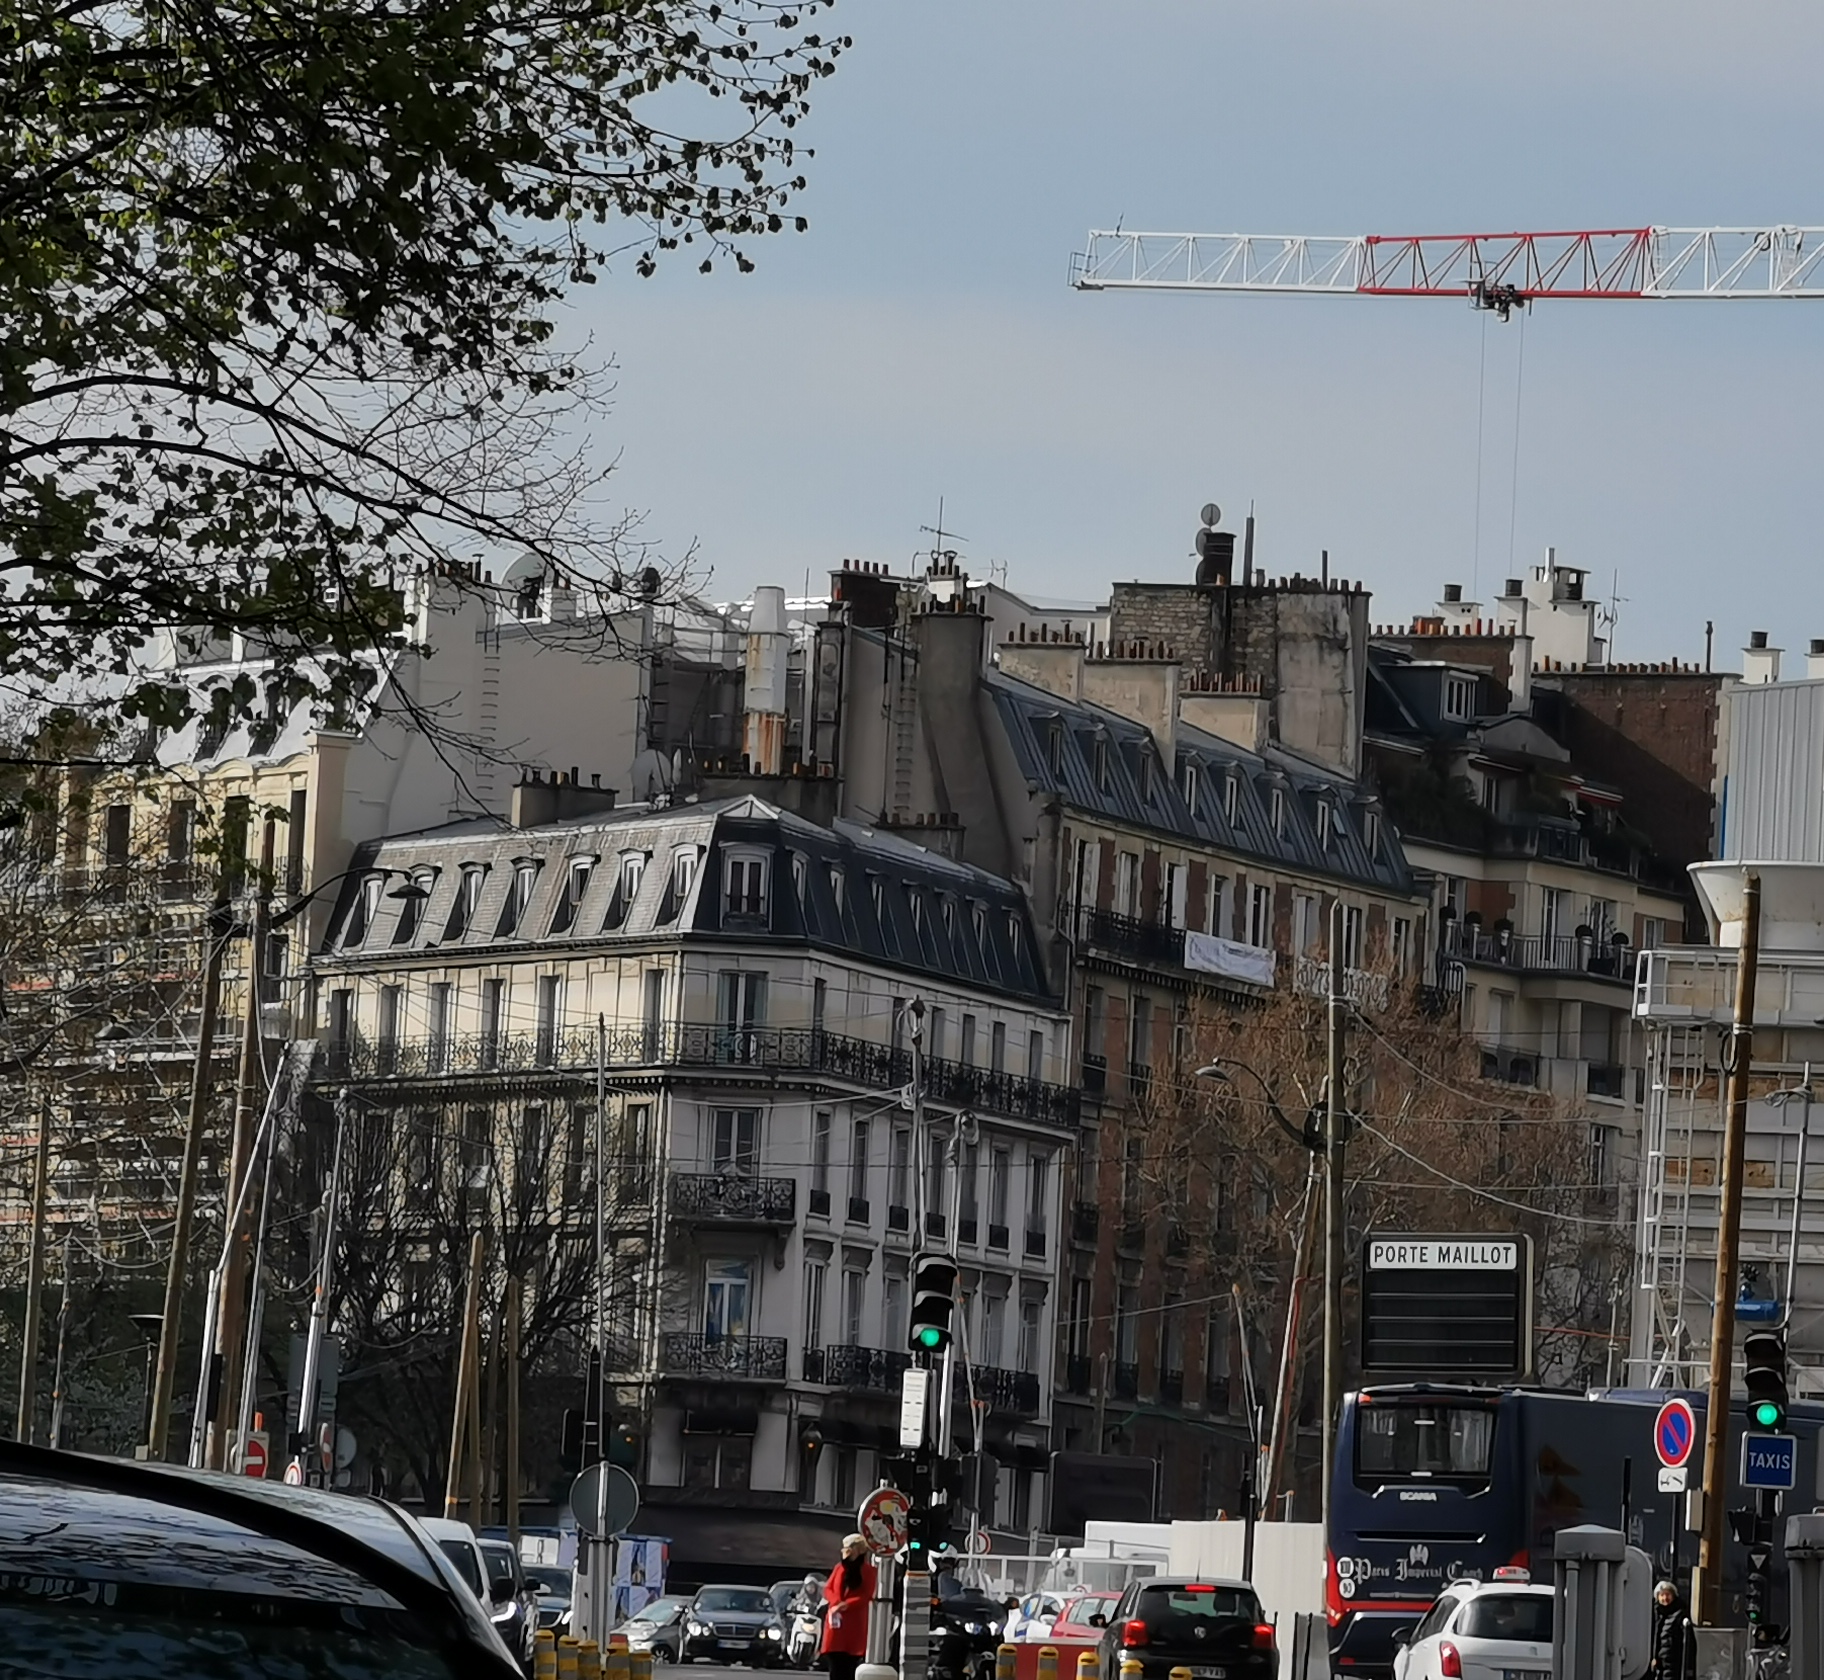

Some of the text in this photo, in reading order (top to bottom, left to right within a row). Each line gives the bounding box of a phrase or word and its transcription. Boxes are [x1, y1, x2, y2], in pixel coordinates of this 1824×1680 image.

[1374, 1245, 1512, 1264] PORTE MAILLOT
[1749, 1451, 1791, 1470] TAXIS
[1353, 1557, 1390, 1585] Paris
[1394, 1558, 1443, 1581] Imperial
